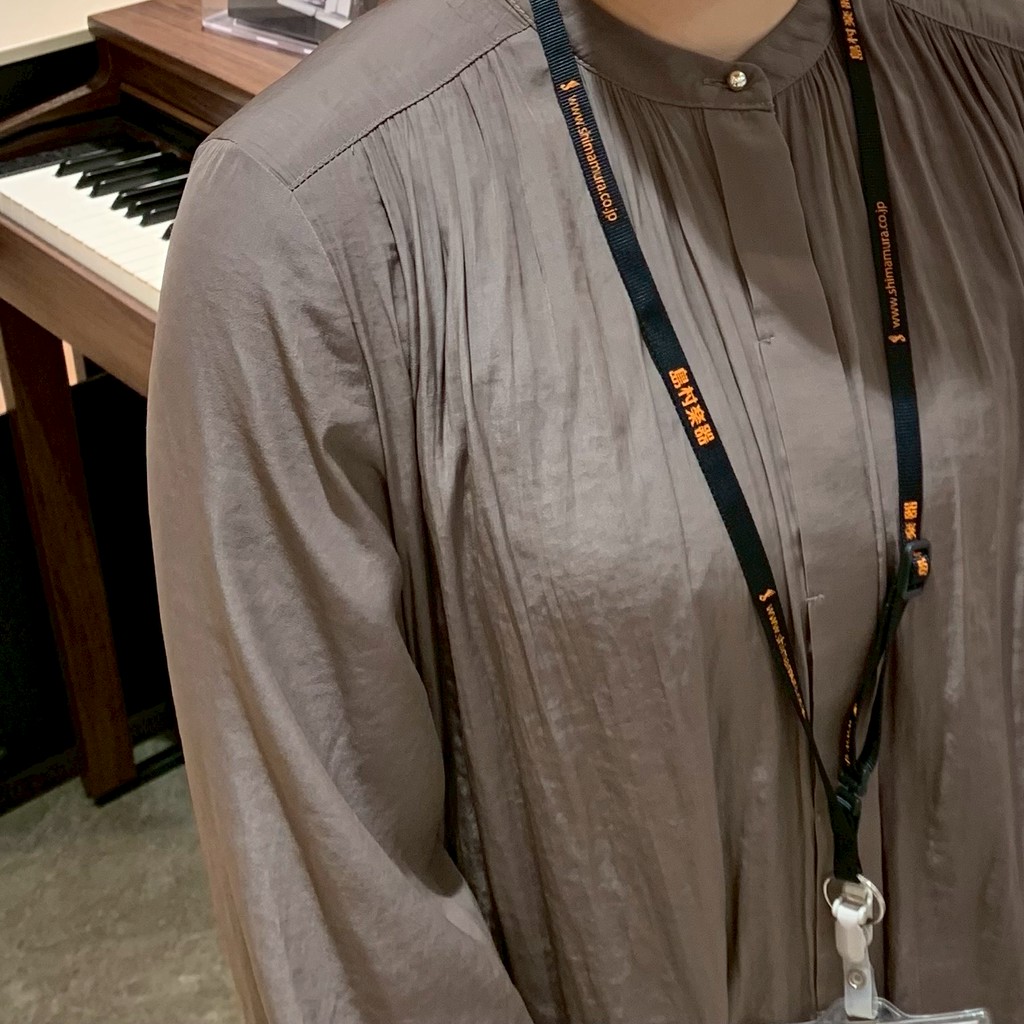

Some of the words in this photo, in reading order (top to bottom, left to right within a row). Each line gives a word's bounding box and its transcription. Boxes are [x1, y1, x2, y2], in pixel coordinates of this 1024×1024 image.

[568, 94, 618, 223] www.shimamura.co.jp
[875, 200, 902, 329] www.shimamura.co.jp
[668, 366, 715, 446] 島村楽器
